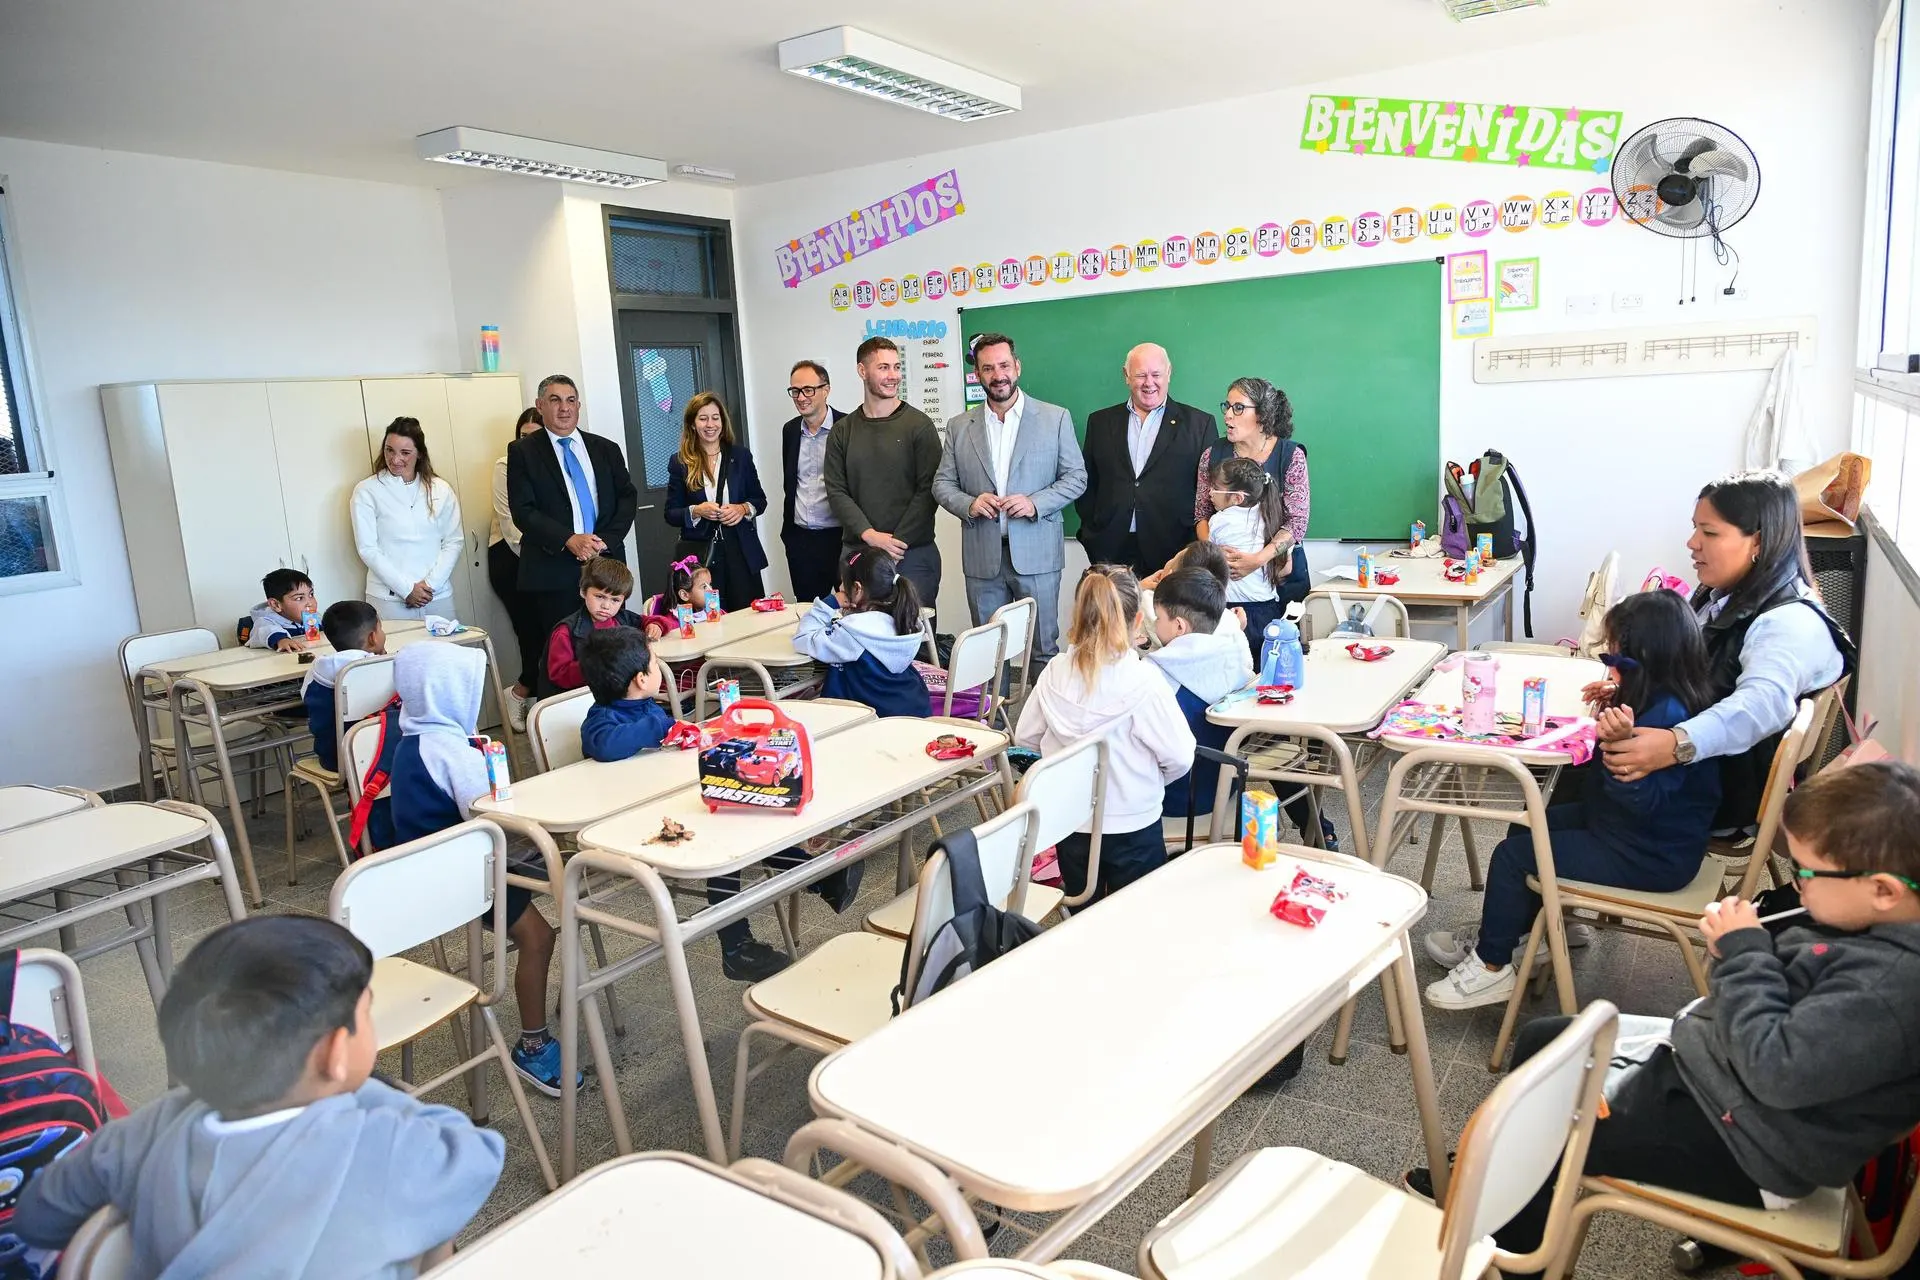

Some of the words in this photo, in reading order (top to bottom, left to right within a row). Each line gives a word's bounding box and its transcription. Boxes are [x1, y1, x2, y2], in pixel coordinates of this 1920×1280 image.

[1305, 96, 1617, 166] BIENVENIDAS
[776, 172, 958, 281] BIENVENIDOS
[702, 785, 791, 807] MASTERS
